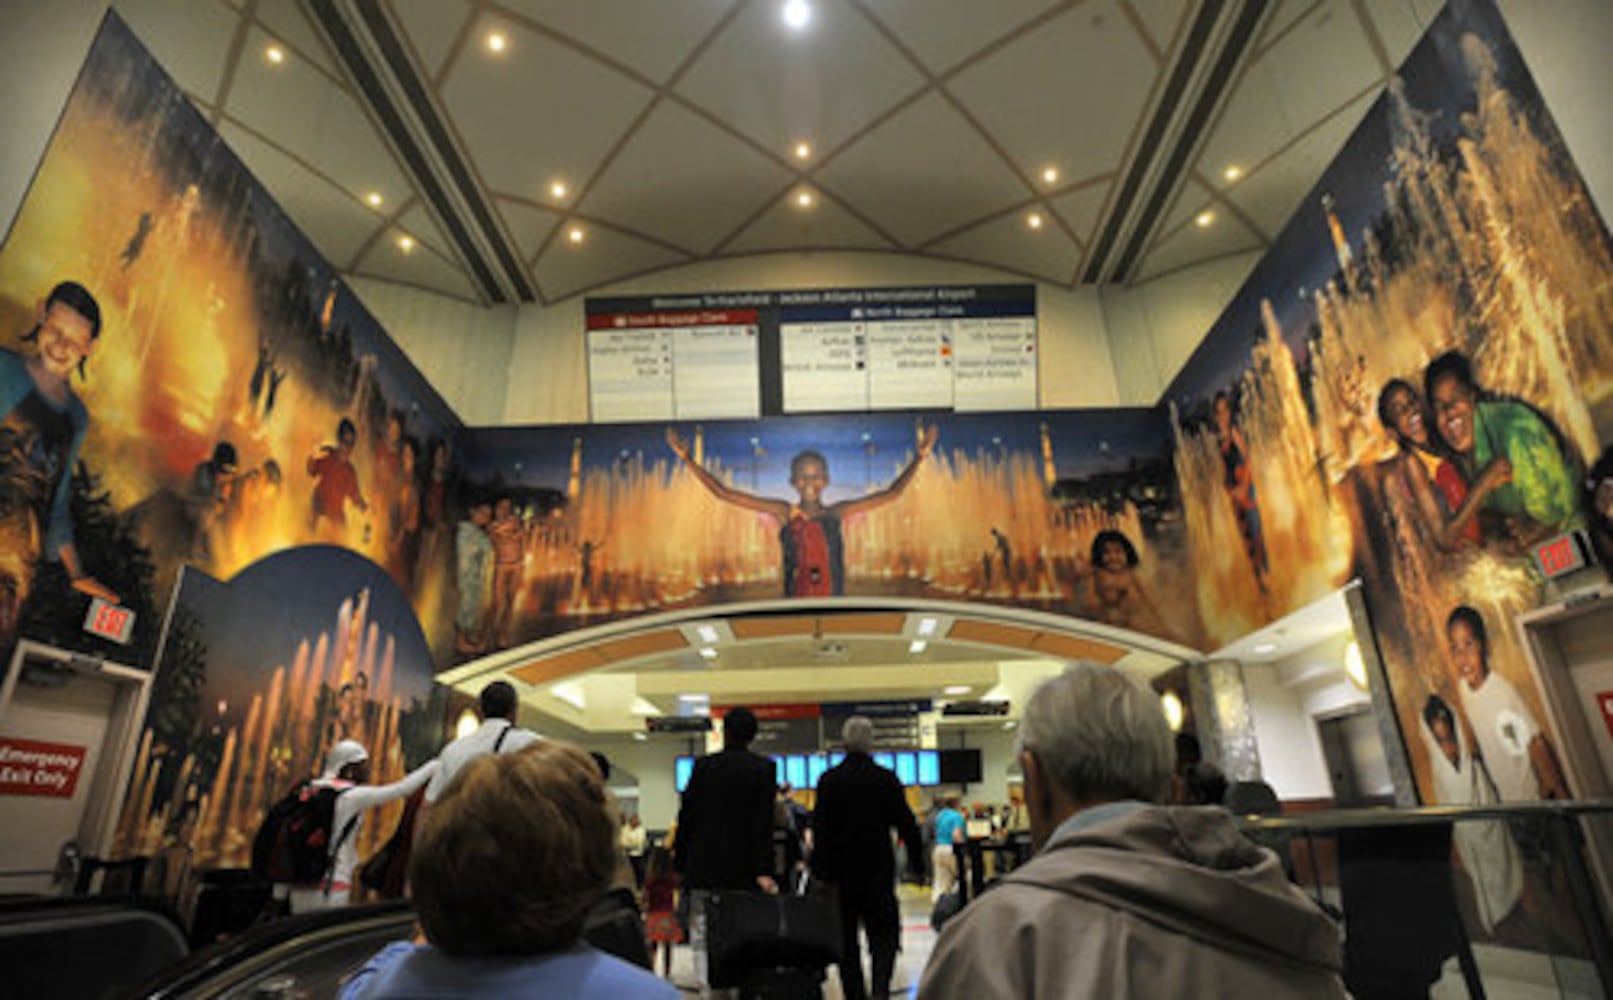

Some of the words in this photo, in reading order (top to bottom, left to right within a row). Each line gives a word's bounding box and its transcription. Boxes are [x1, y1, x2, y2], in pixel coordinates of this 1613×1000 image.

[1539, 537, 1577, 577] EXIT
[93, 603, 129, 639] EXIT
[0, 746, 80, 770] Emergency
[0, 767, 31, 787] Exit
[34, 769, 68, 790] Only
